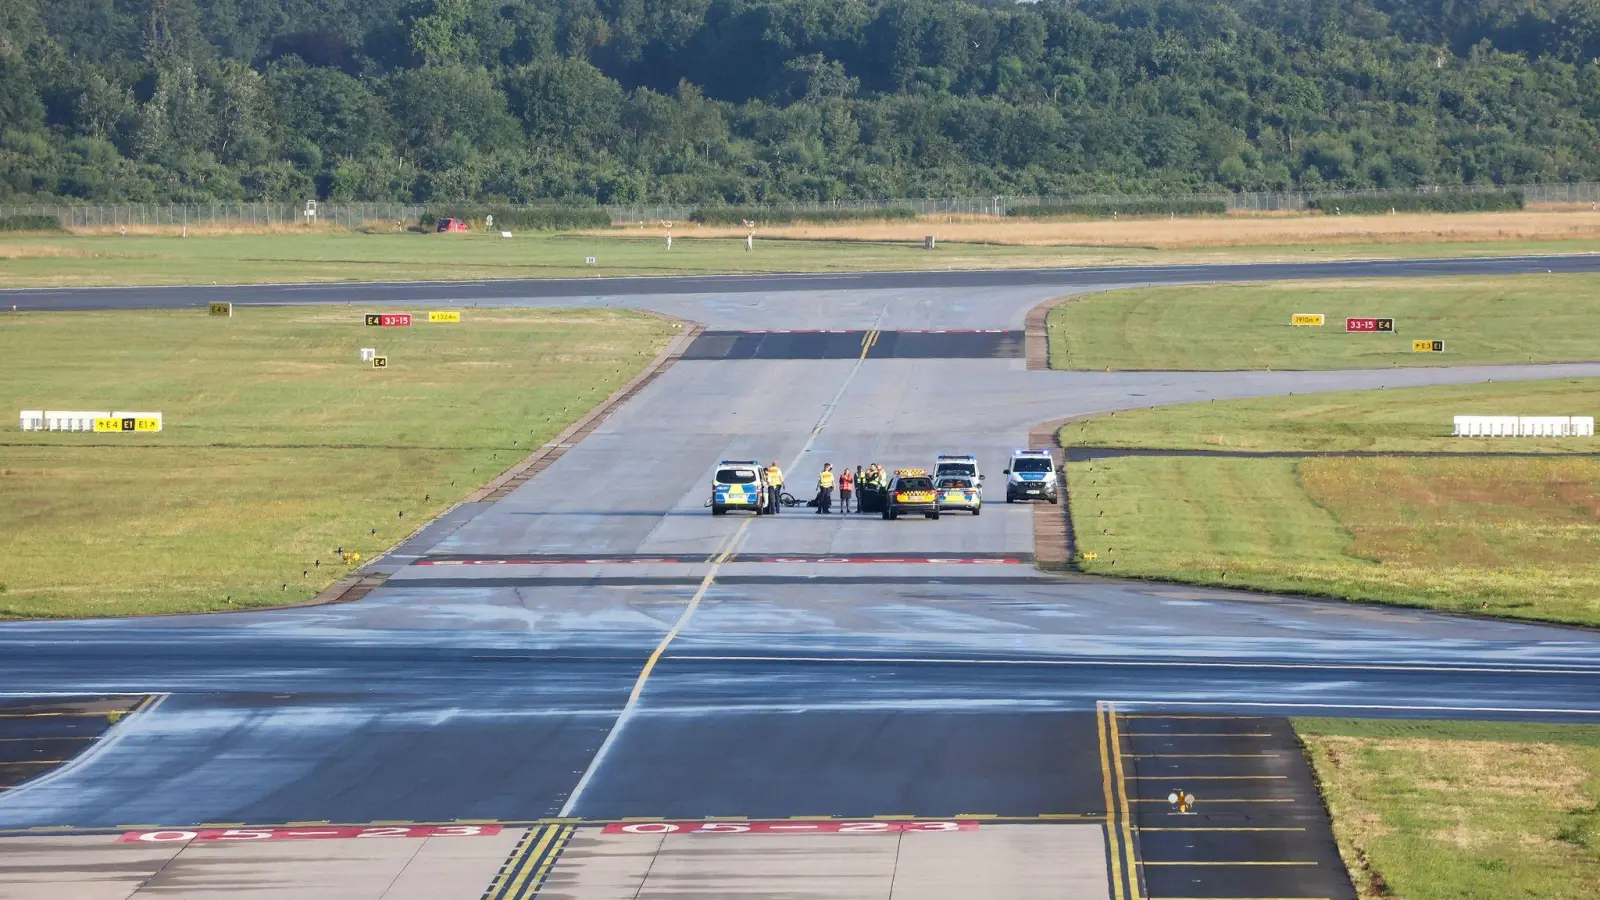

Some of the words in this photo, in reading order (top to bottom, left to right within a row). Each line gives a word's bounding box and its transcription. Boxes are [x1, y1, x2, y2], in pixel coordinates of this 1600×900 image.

[367, 317, 379, 325] E4
[385, 317, 408, 325] 33-15
[1350, 321, 1374, 329] 33-15
[106, 420, 118, 428] E4
[124, 421, 133, 429] E1
[138, 420, 147, 428] E1
[622, 822, 959, 833] 05-23
[138, 826, 481, 841] 05-23
